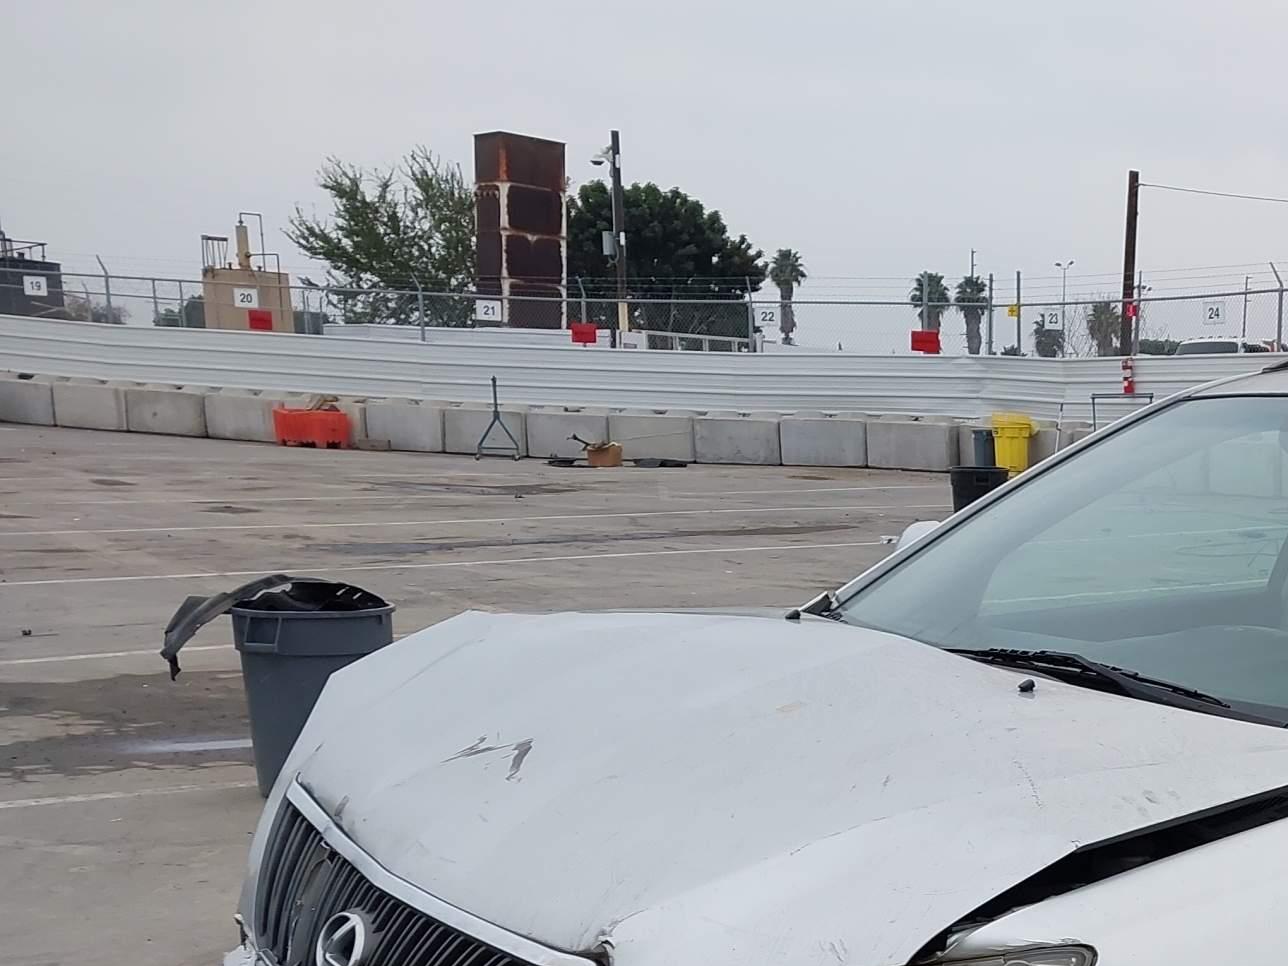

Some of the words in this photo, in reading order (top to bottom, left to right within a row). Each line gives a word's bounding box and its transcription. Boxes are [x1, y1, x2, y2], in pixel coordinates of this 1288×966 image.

[29, 280, 42, 291] 19
[239, 292, 253, 304] 20
[483, 304, 496, 316] 21
[1208, 307, 1220, 320] 24
[760, 311, 775, 322] 22
[1048, 312, 1059, 325] 23
